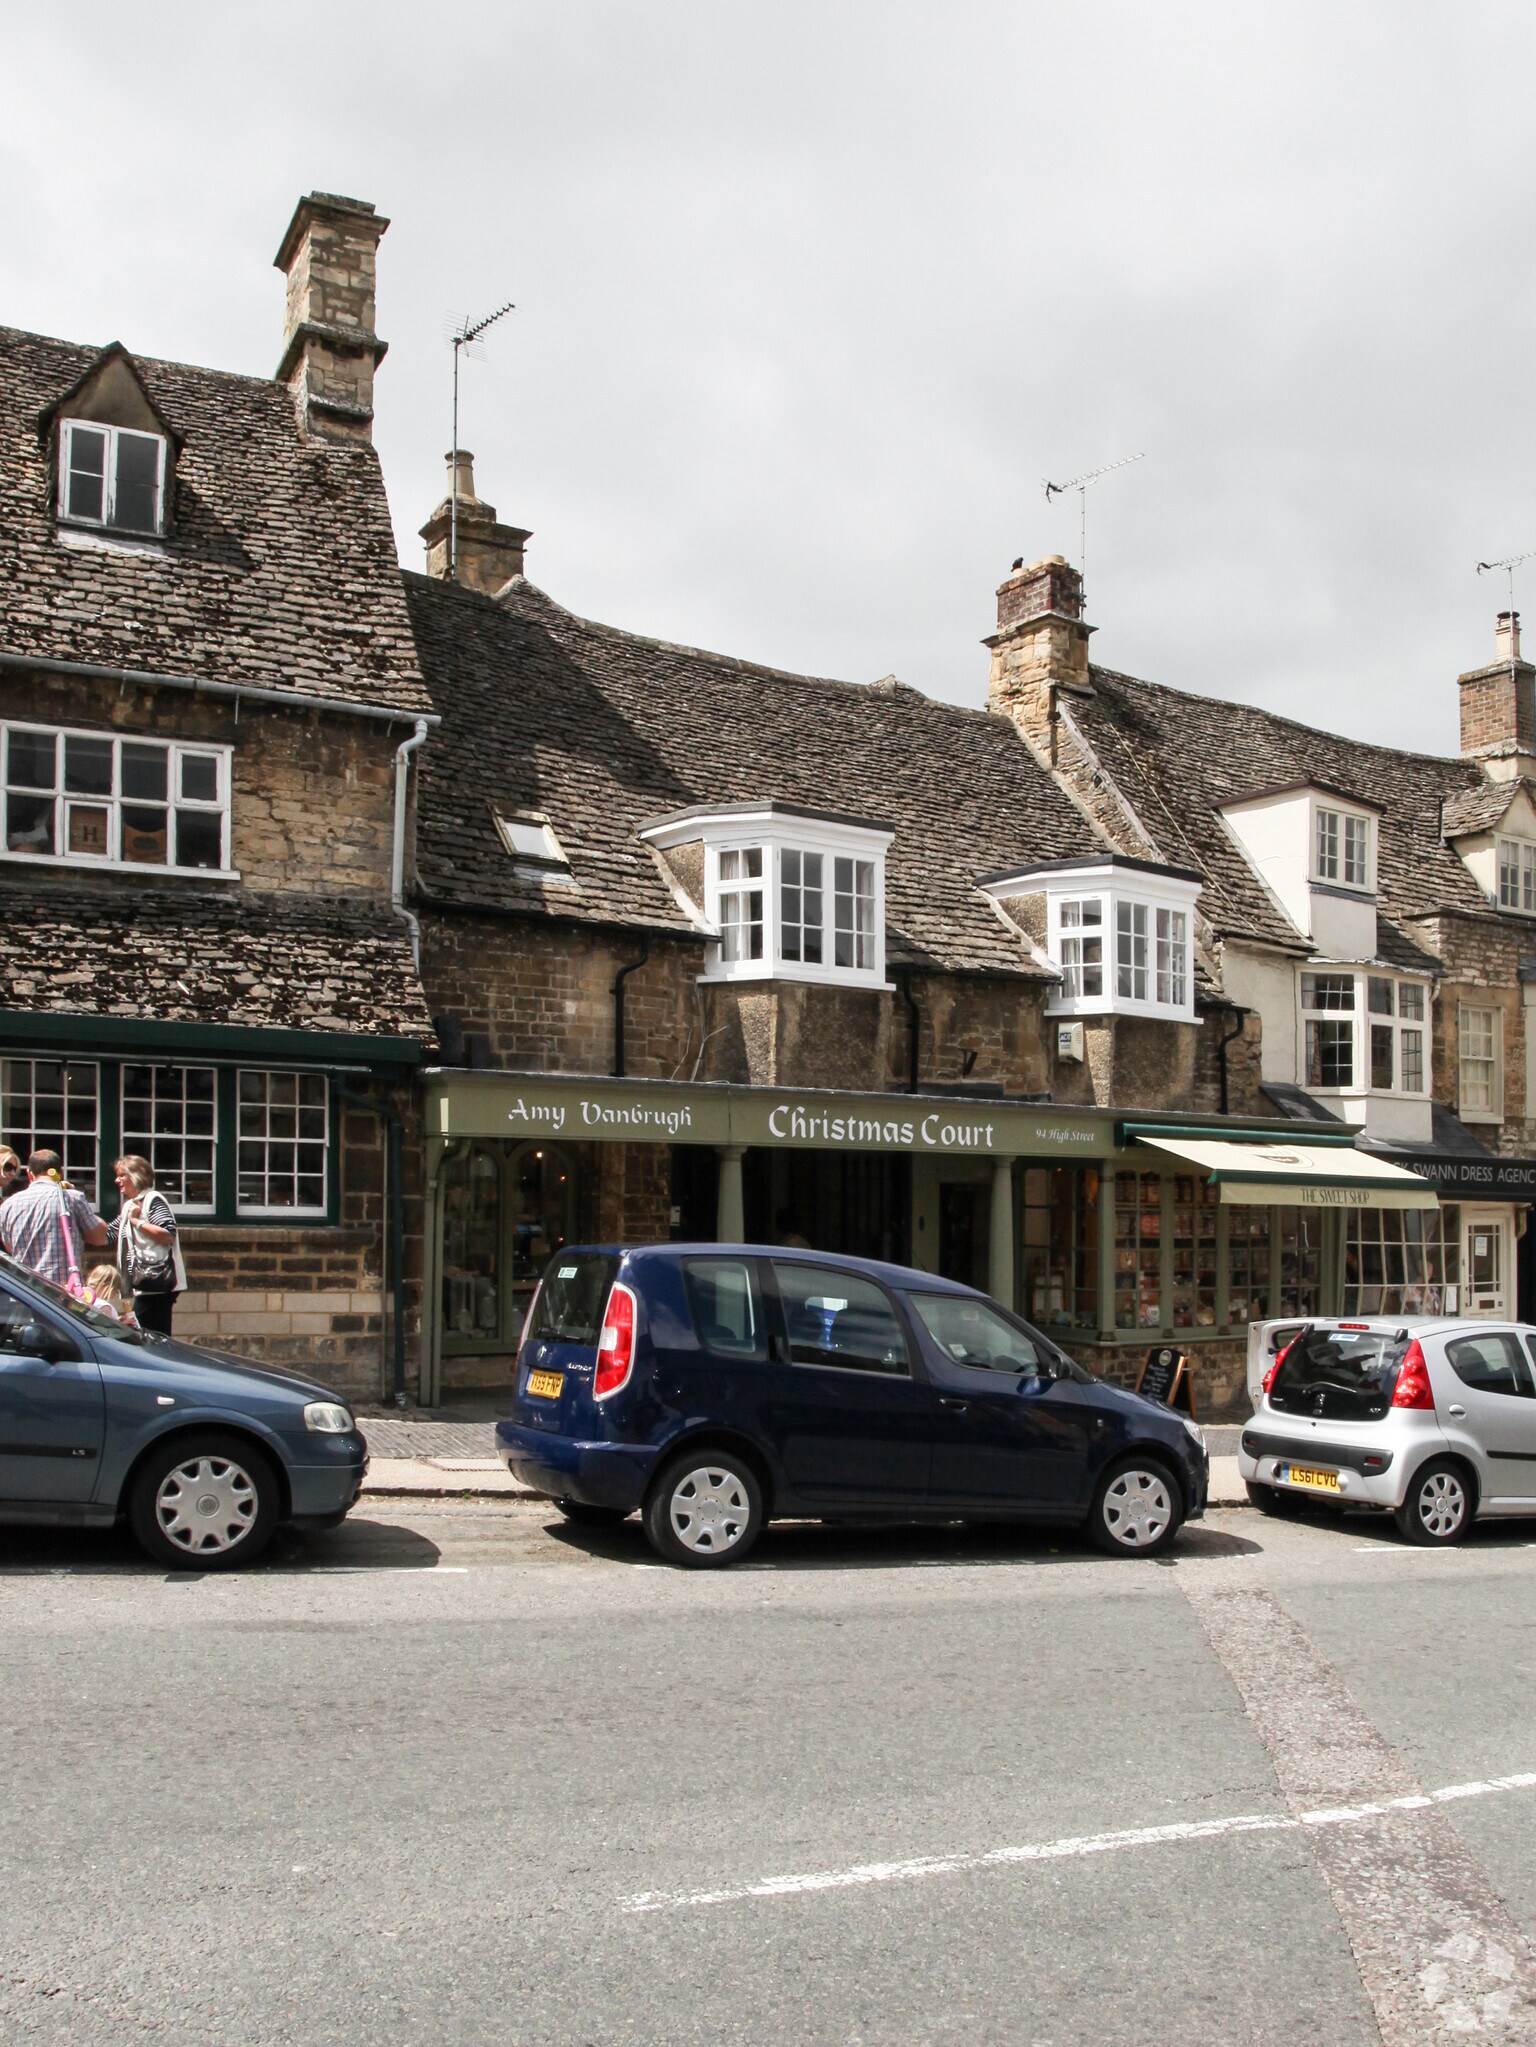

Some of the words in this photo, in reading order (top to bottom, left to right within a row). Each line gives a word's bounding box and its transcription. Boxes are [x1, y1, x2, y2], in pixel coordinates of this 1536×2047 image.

[508, 1099, 565, 1129] Amy
[580, 1101, 691, 1134] Vanbrugh
[768, 1105, 914, 1144] Christmas
[921, 1114, 994, 1147] Court
[1036, 1128, 1046, 1138] 94
[1048, 1128, 1069, 1144] High
[1070, 1130, 1094, 1141] Street
[1413, 1162, 1457, 1179] SWANN
[1461, 1165, 1493, 1182] DRESS
[1301, 1188, 1317, 1203] THE
[1319, 1189, 1347, 1204] SWEET
[1349, 1190, 1369, 1205] SHOP
[1292, 1467, 1315, 1484] LS61
[1316, 1471, 1337, 1487] CVO
